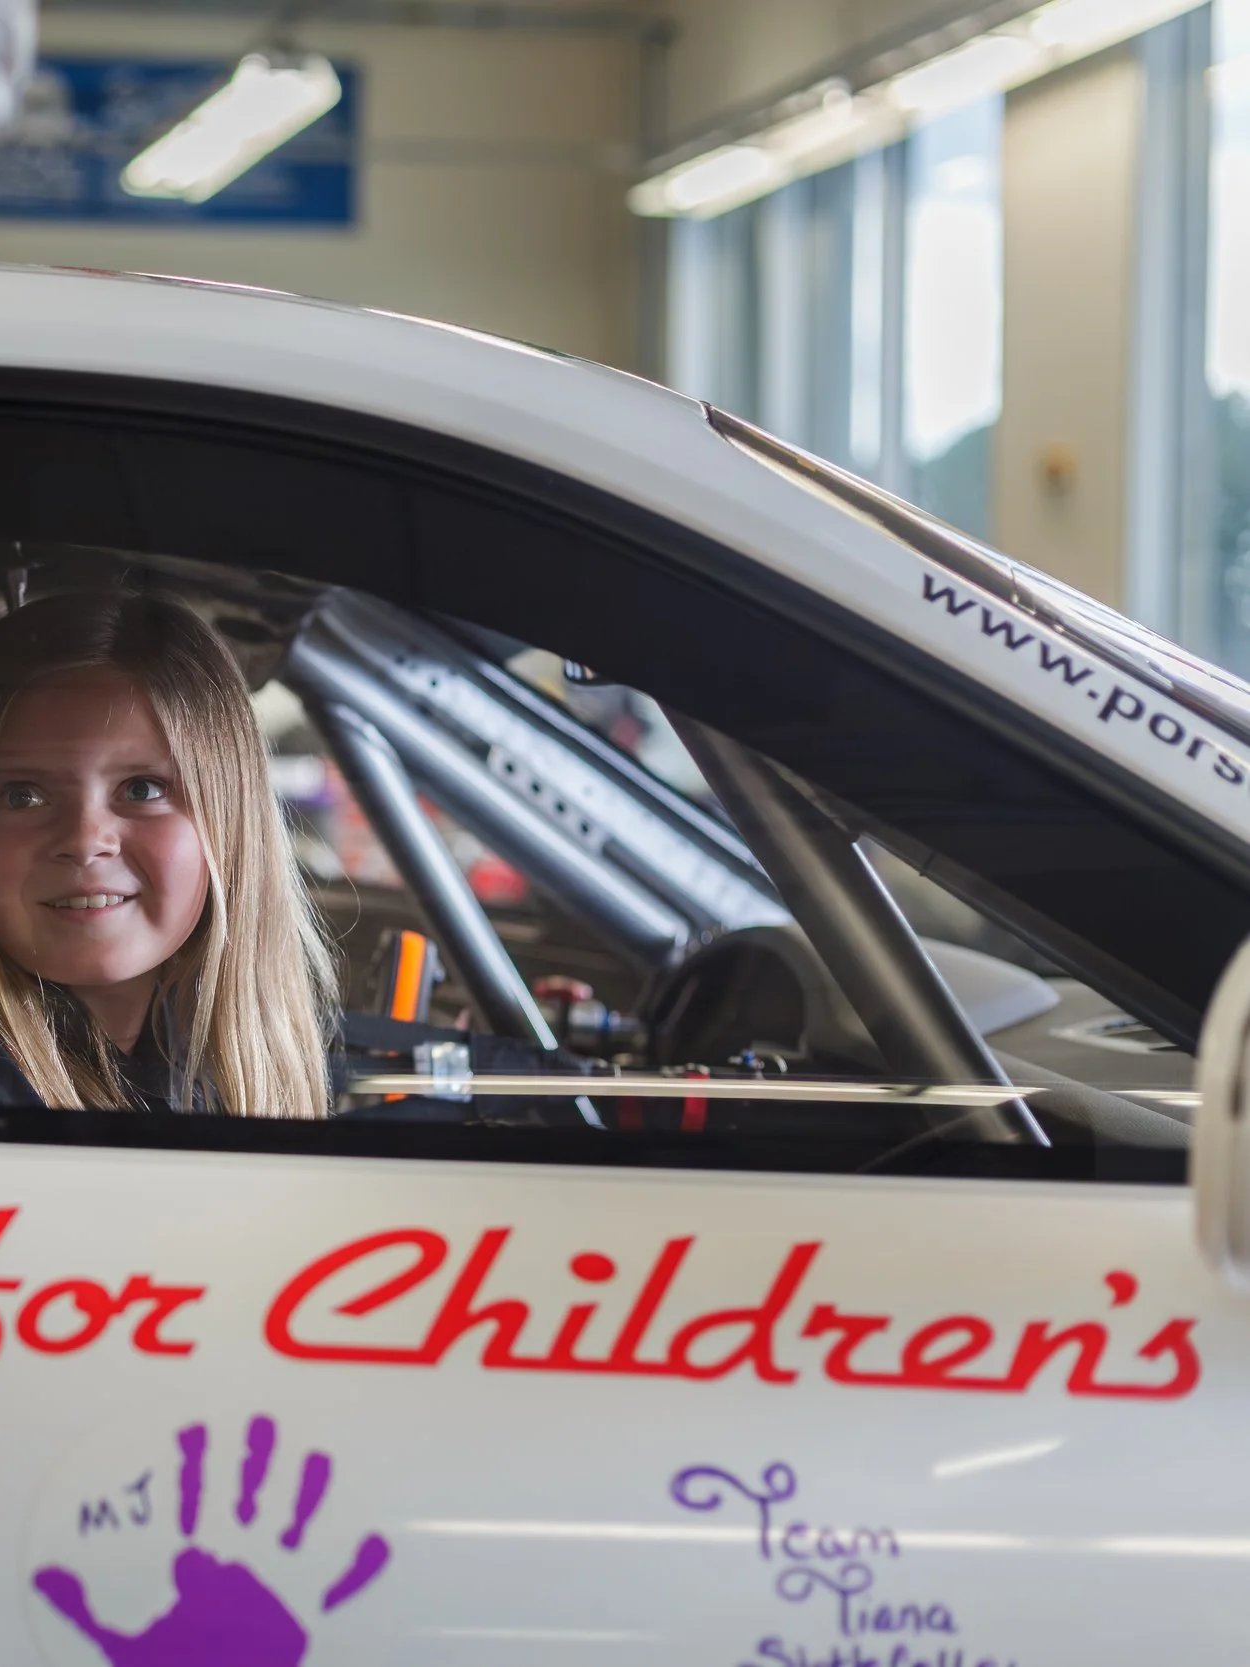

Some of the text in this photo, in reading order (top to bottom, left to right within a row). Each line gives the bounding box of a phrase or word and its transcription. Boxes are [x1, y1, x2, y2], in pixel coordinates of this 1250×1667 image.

[263, 1225, 1201, 1400] Children's
[668, 1461, 901, 1561] Team
[775, 1562, 958, 1637] Tiana
